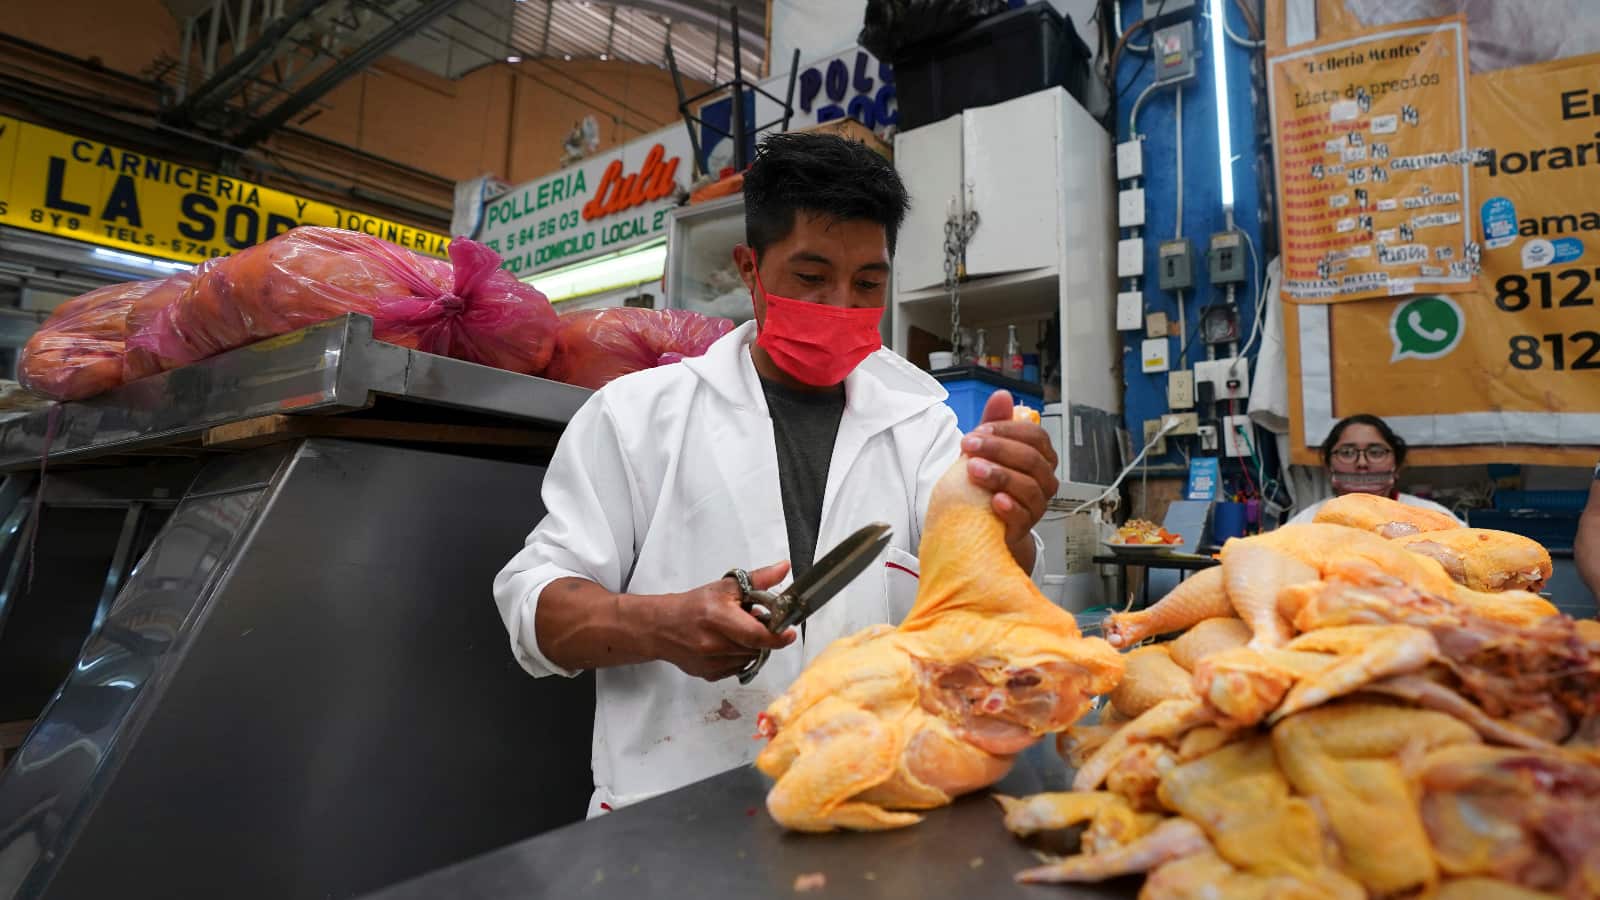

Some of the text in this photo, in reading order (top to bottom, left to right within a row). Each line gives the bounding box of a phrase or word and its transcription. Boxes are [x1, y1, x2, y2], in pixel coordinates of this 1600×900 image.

[1368, 73, 1440, 97] precios
[45, 156, 143, 228] LA
[72, 141, 259, 207] CARNICERIA
[295, 200, 307, 219] Y
[487, 169, 586, 230] POLLERIA
[582, 143, 680, 223] Lulu
[534, 231, 595, 267] DOMICILIO
[602, 216, 648, 246] LOCAL
[559, 209, 579, 230] 03
